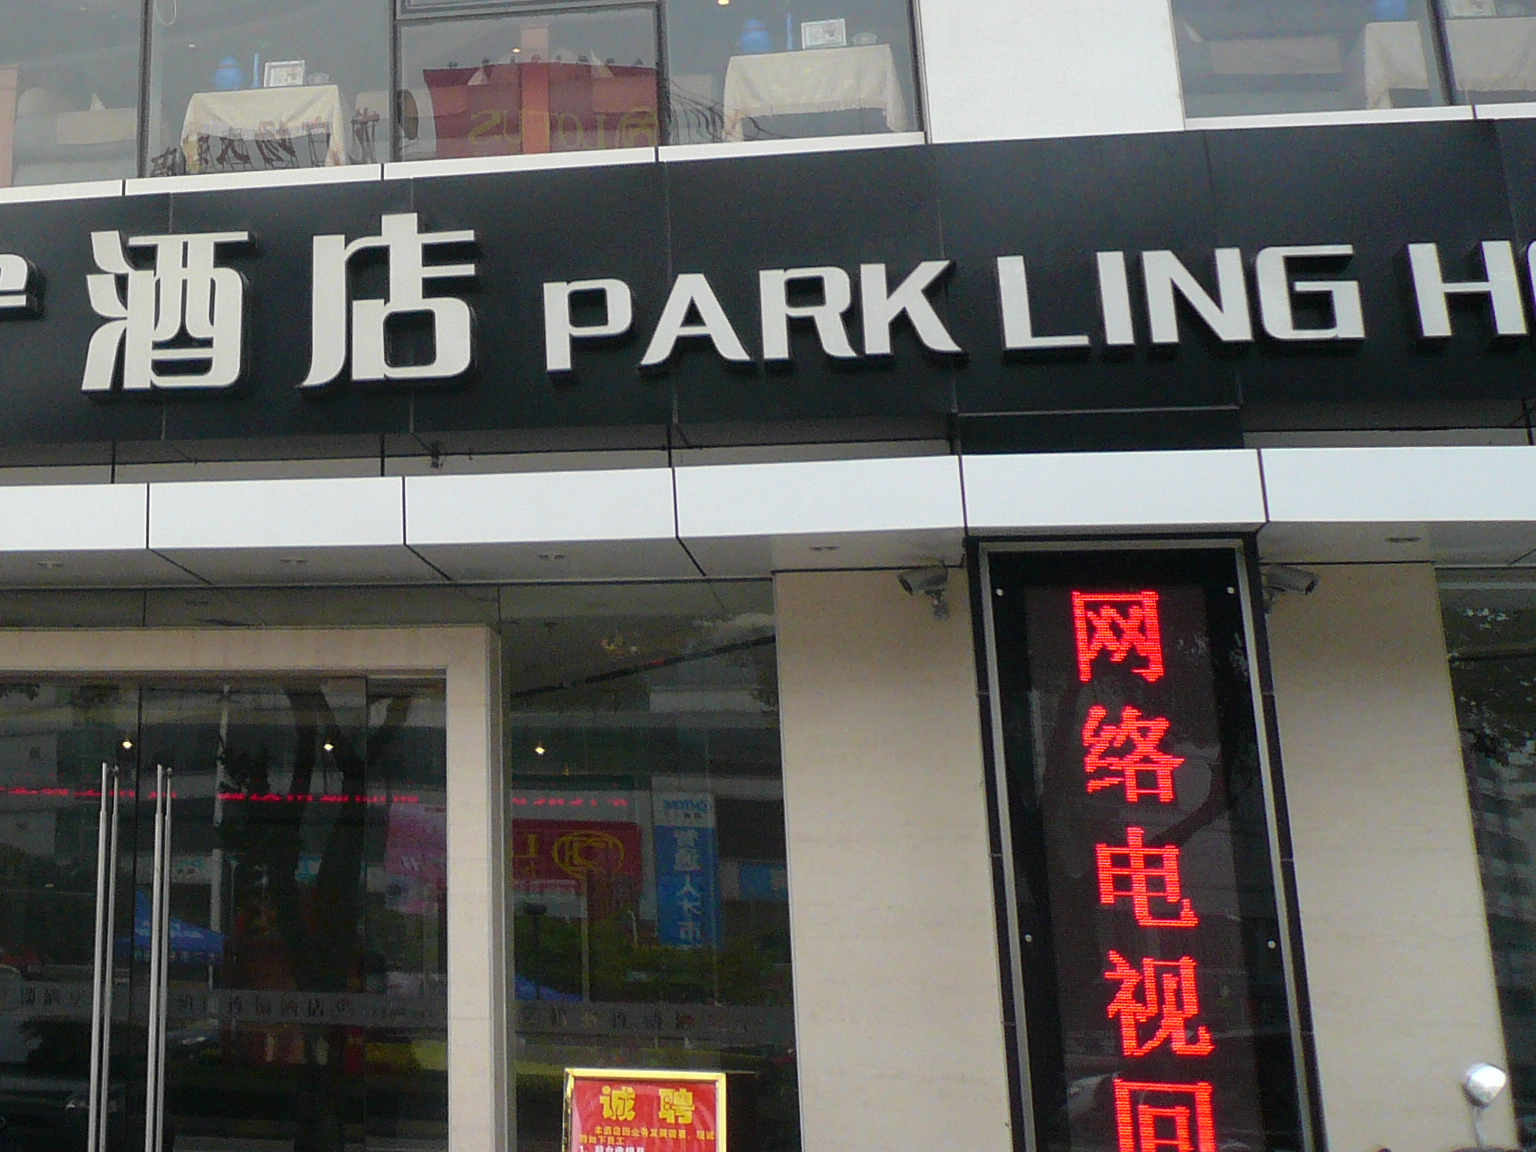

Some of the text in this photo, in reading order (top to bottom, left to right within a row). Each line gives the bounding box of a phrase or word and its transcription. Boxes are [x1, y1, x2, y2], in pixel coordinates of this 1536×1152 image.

[543, 239, 1536, 374] PARK LING H
[600, 1085, 695, 1125] 诚聘
